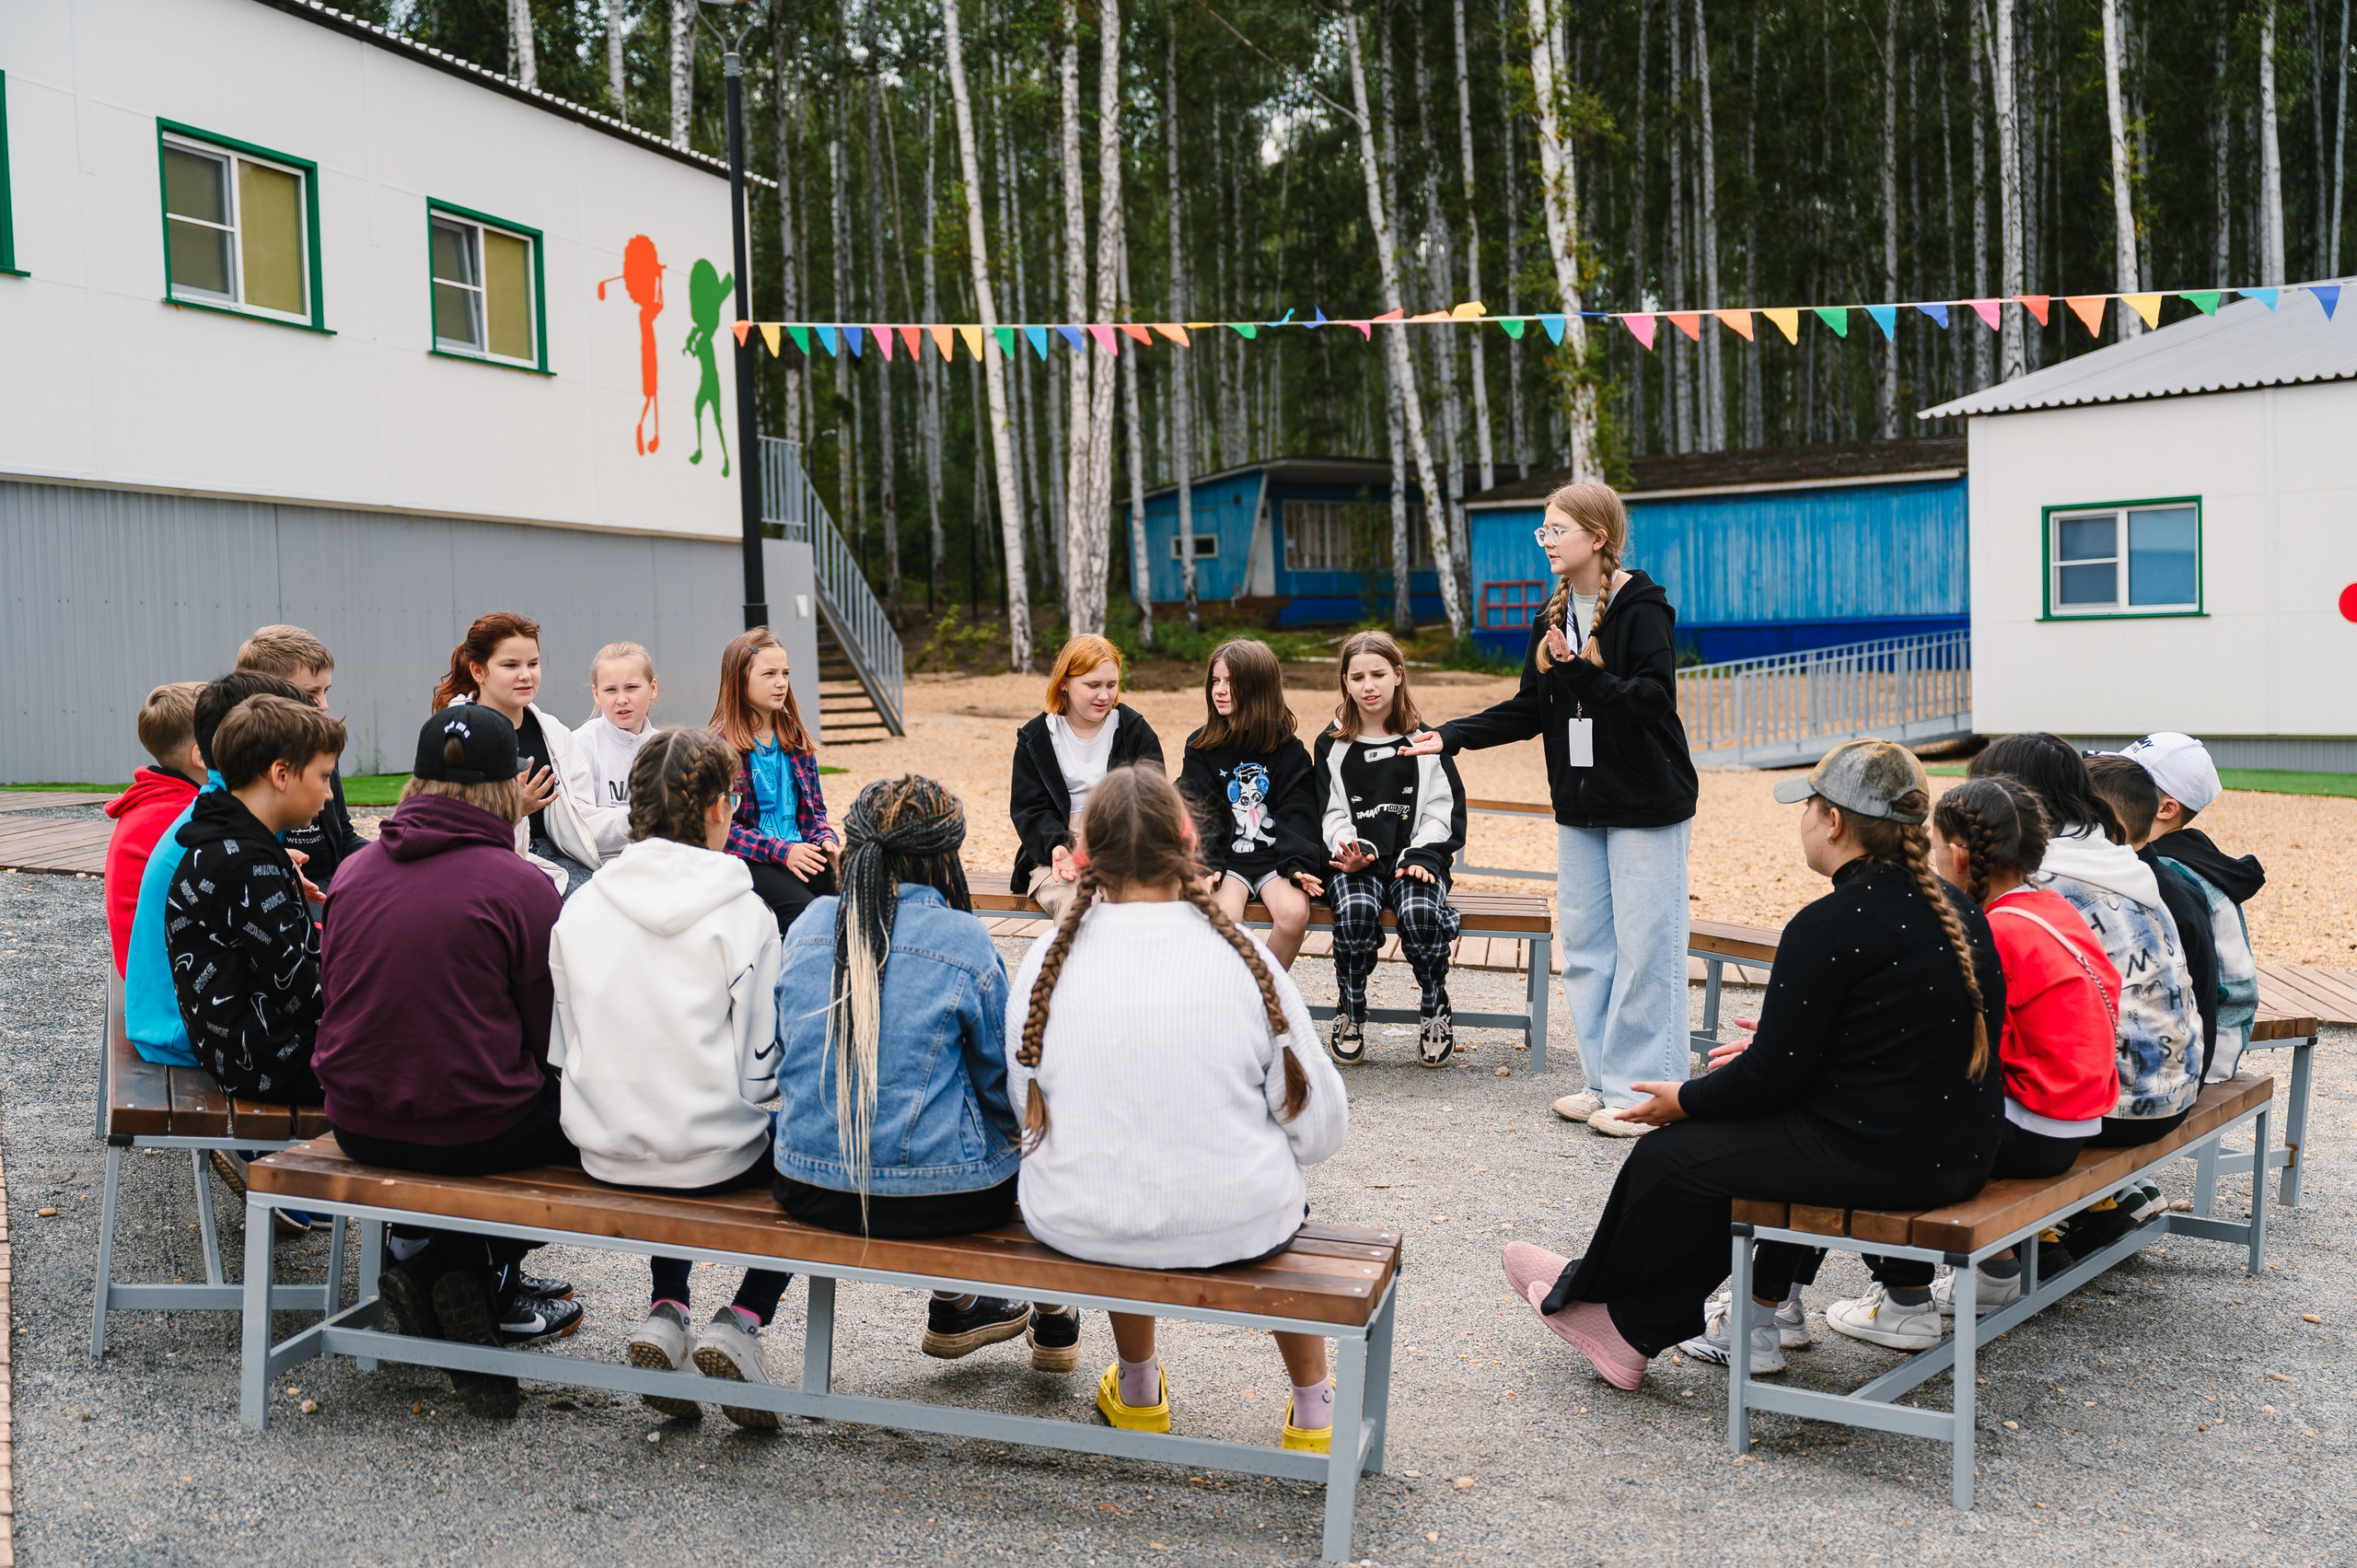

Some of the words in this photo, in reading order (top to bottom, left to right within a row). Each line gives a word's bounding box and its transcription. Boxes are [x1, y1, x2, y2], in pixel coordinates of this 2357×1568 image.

[261, 891, 286, 913] NIKE
[243, 922, 272, 946] NIKE
[192, 962, 217, 993] NIKE
